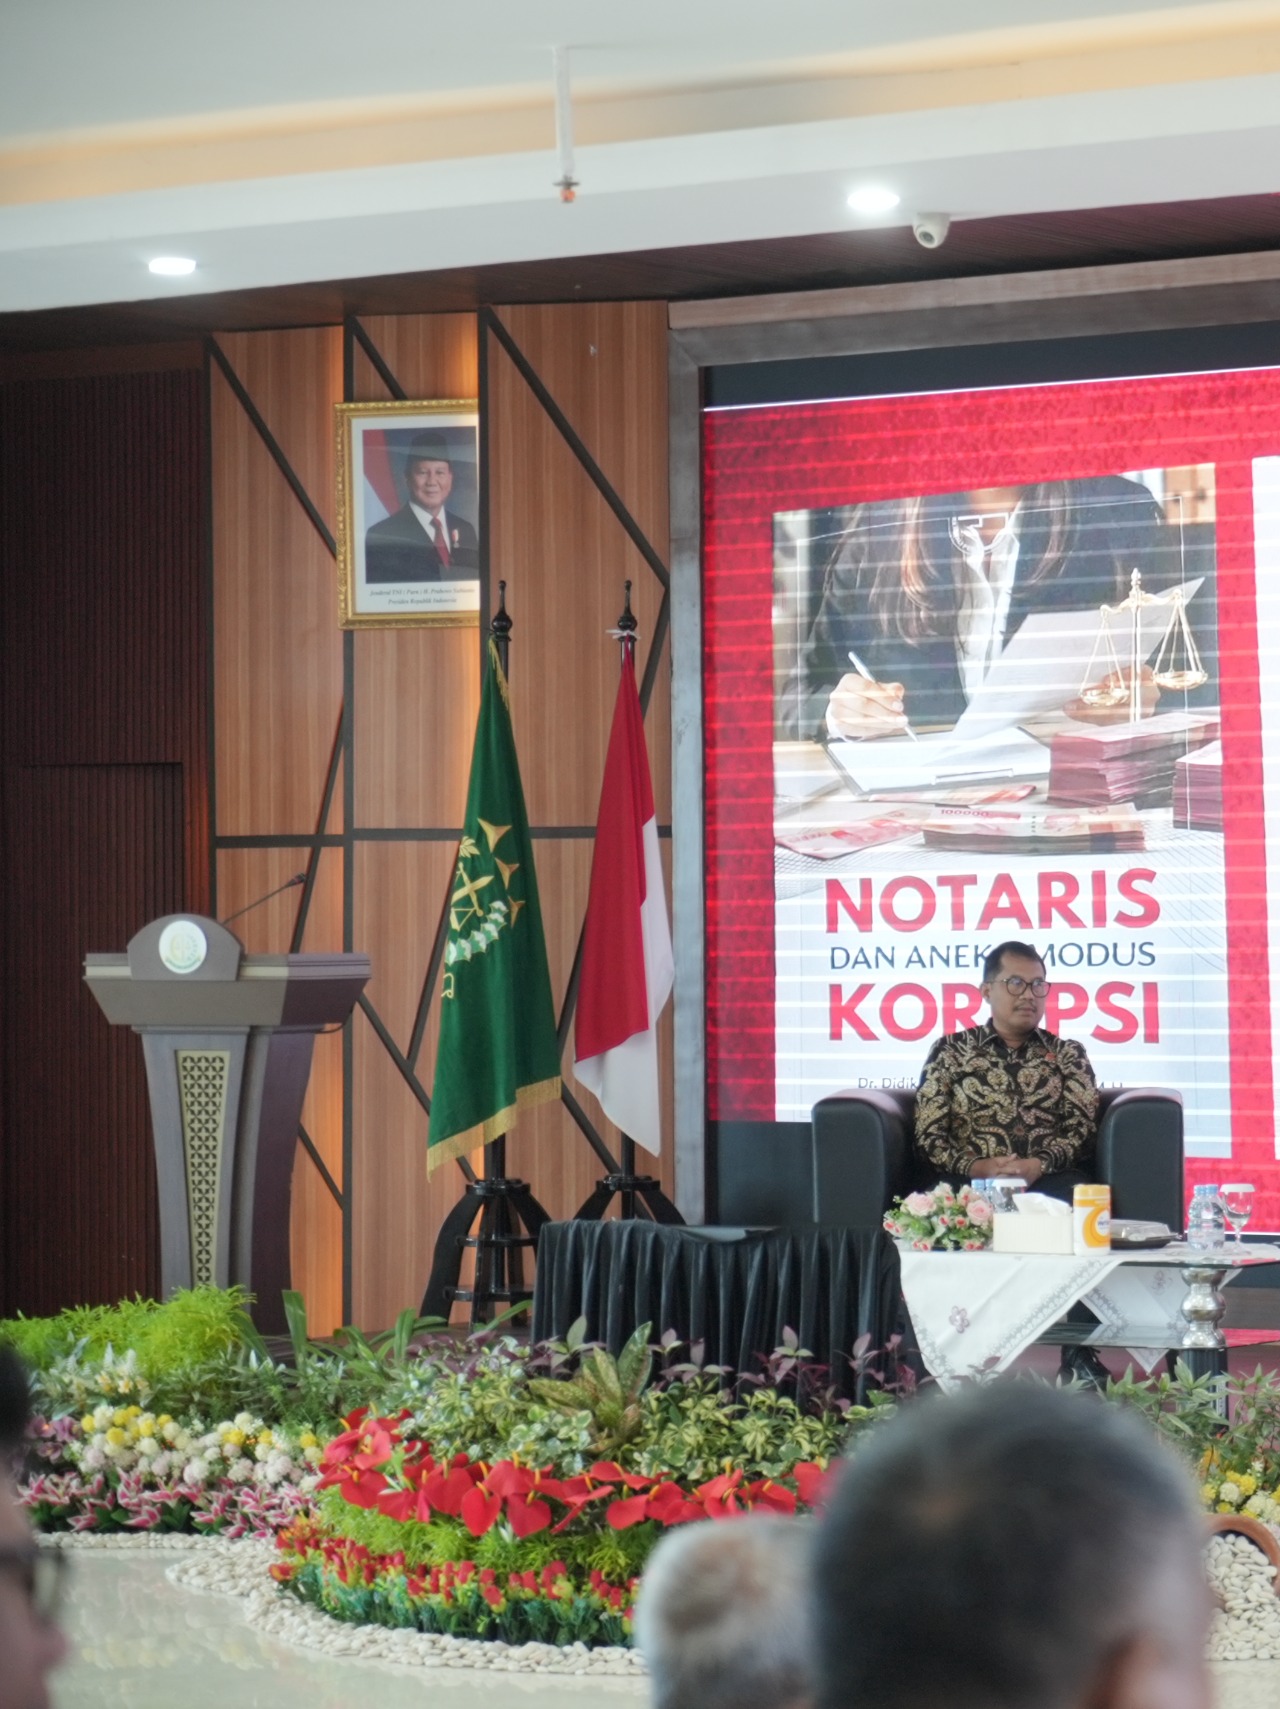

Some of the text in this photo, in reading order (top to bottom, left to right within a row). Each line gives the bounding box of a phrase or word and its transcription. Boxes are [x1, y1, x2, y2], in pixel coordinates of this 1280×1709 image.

[825, 868, 1161, 933] NOTARIS
[830, 945, 896, 970] DAN
[905, 944, 992, 969] ANEK
[829, 981, 1159, 1044] KORPSI
[857, 1077, 917, 1089] Dr. Didik
